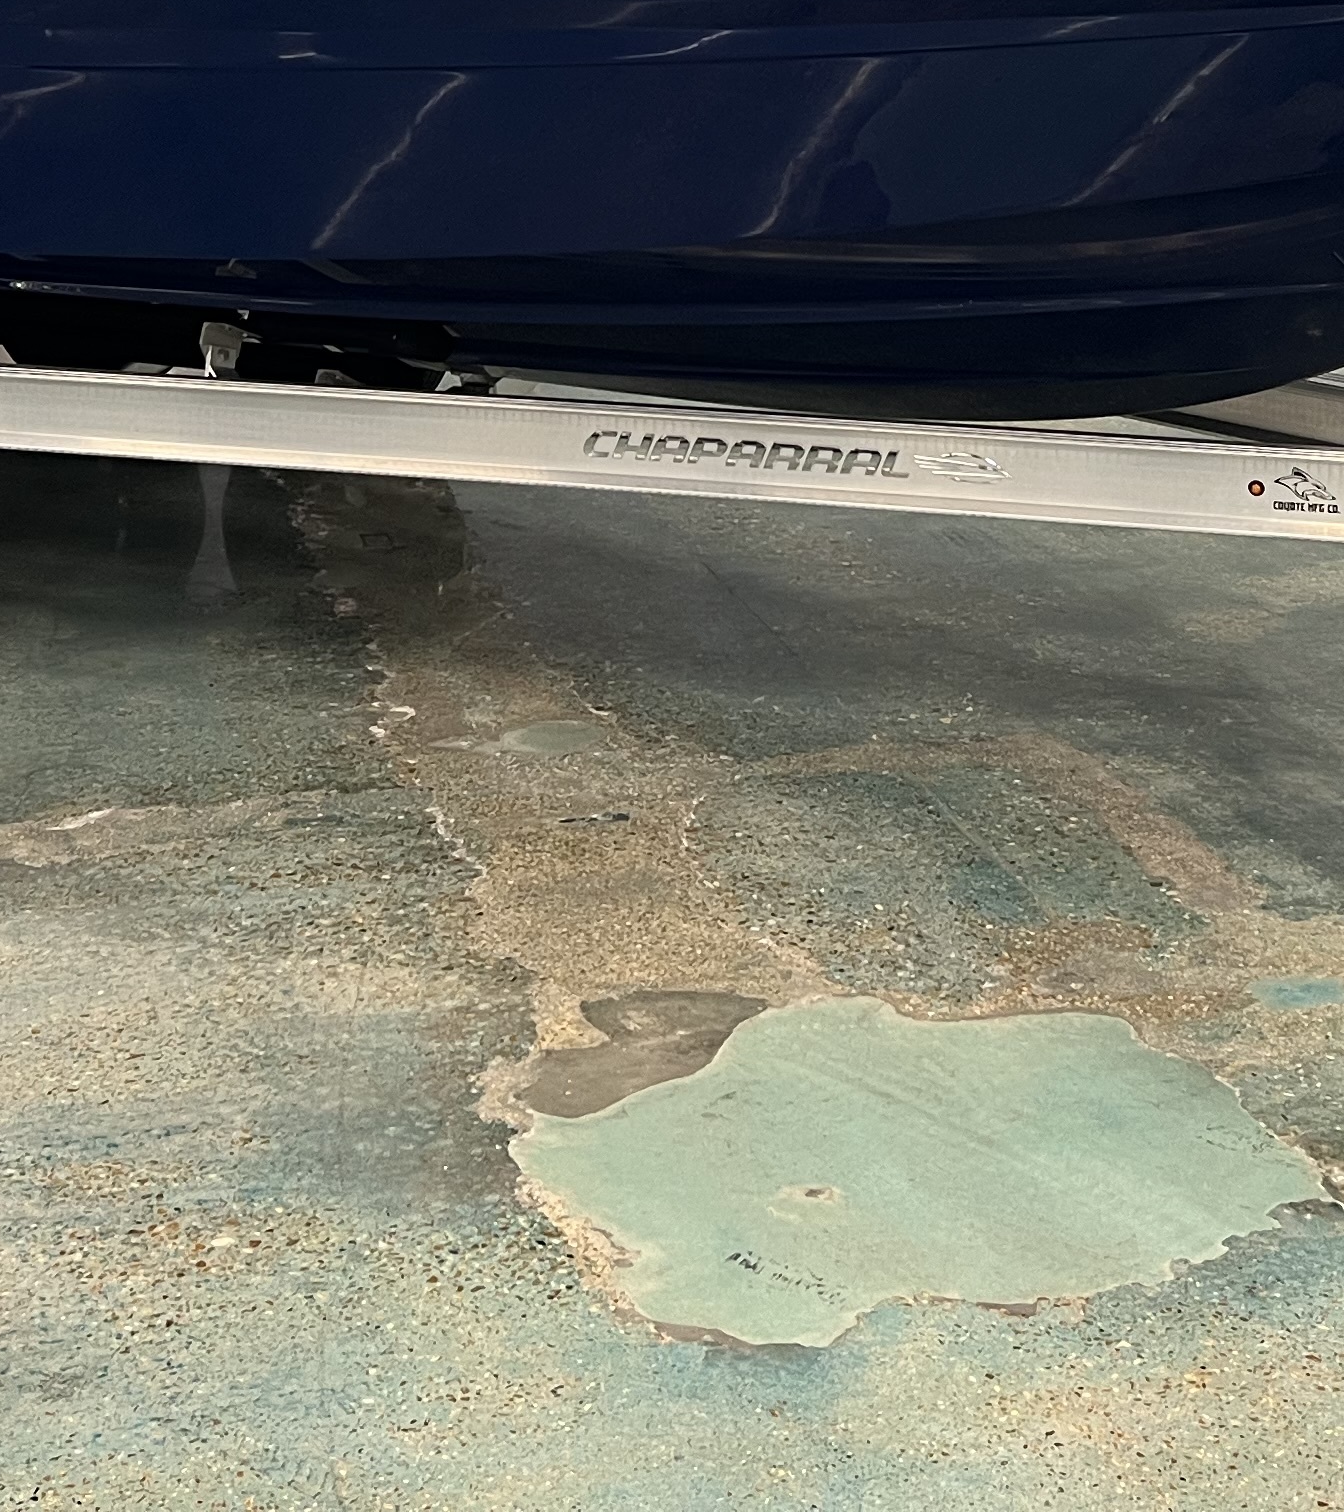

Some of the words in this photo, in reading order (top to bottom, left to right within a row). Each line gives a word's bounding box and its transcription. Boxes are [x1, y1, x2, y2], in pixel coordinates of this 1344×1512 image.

[582, 430, 910, 479] CHAPARRAL
[1272, 500, 1306, 512] COYOTE
[1307, 502, 1325, 513] MFG
